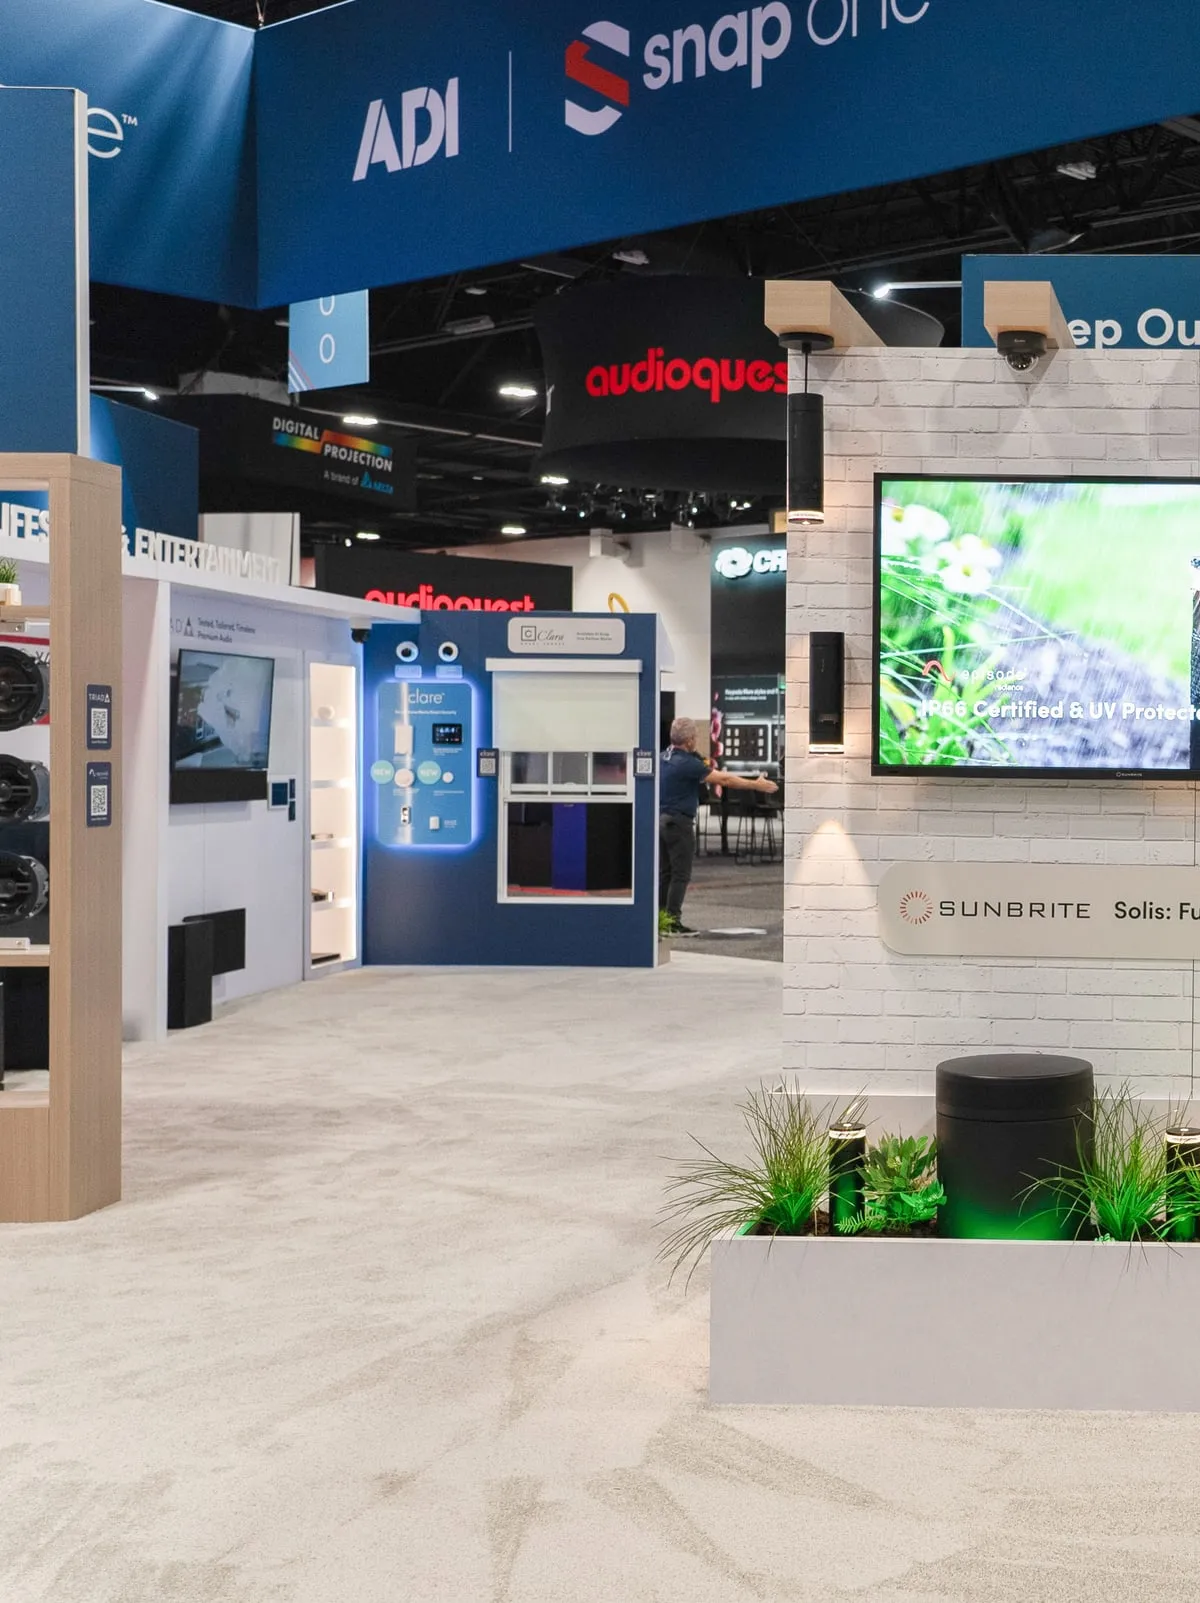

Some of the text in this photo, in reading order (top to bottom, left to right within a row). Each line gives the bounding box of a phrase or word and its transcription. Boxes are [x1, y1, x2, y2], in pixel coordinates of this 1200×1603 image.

[643, 1, 792, 90] snap
[353, 77, 459, 182] ADI
[272, 417, 319, 440] DIGITAL
[324, 443, 393, 472] PROJECTION
[922, 702, 967, 717] IP66
[973, 700, 1063, 719] Certified
[1069, 702, 1084, 719] &
[1090, 702, 1117, 719] UV
[940, 900, 1091, 920] SUNBRITE
[1115, 901, 1172, 921] Solis:
